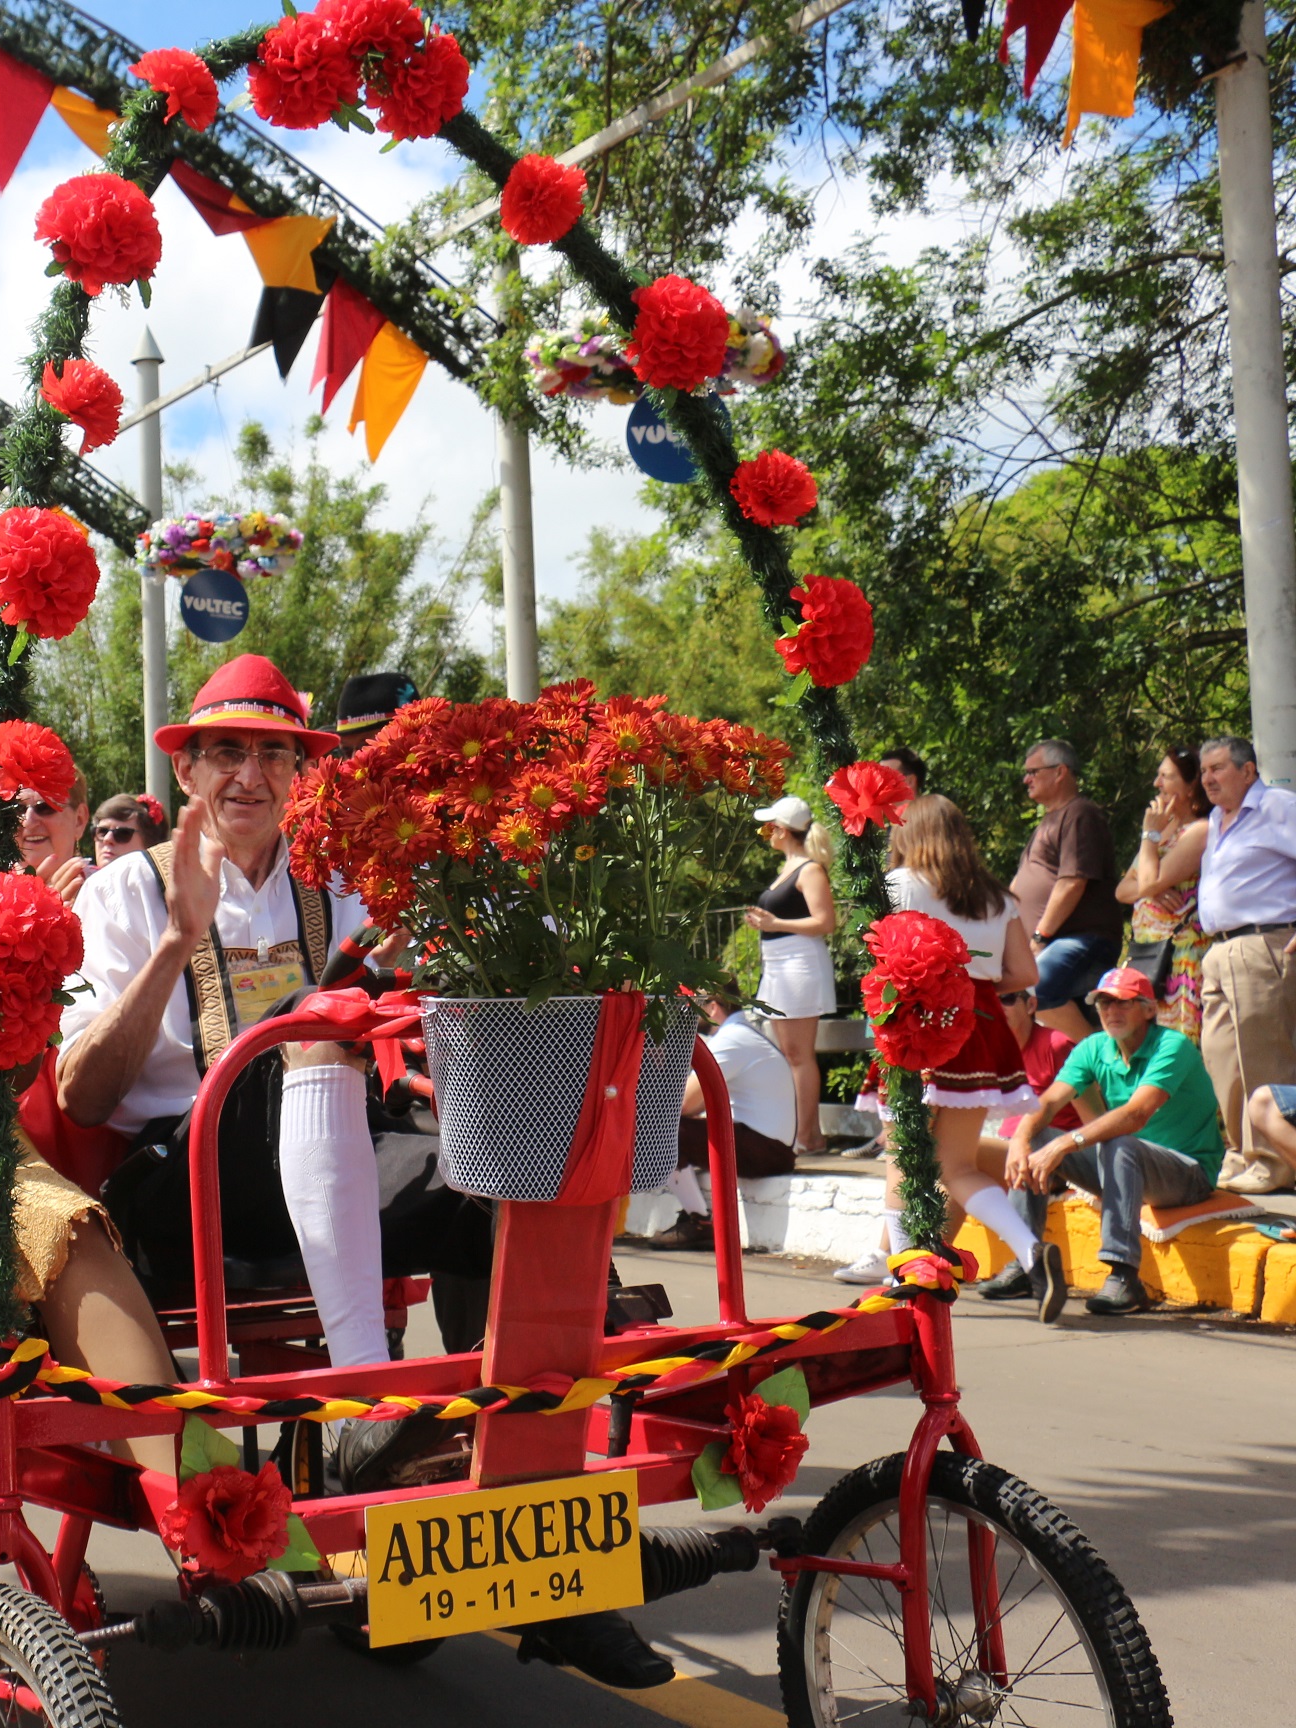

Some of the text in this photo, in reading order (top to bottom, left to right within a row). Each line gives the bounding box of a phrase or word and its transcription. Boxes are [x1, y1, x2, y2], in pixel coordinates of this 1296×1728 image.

[631, 423, 680, 445] VUL
[184, 595, 244, 616] VULTEC
[378, 1491, 632, 1585] AREKERB
